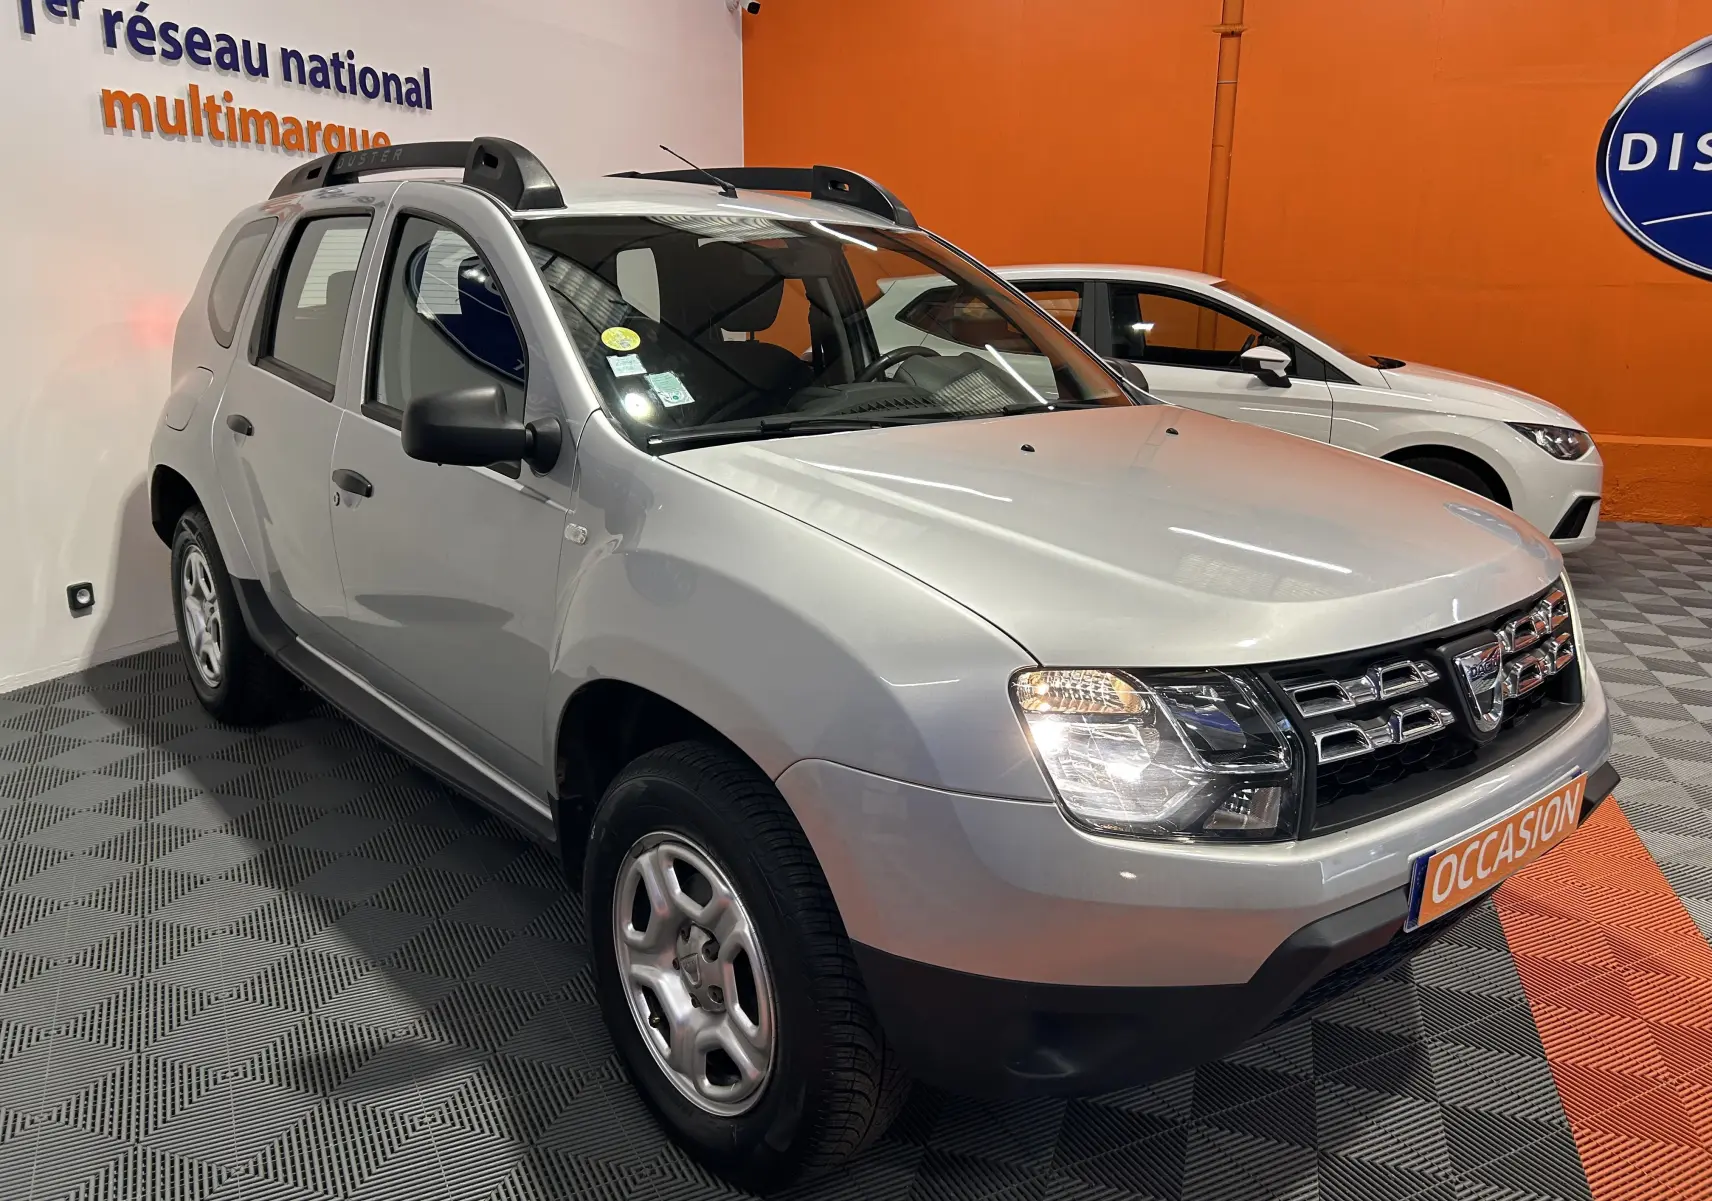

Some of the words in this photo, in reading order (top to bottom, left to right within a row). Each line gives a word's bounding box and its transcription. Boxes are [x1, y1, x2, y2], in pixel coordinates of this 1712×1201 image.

[102, 2, 269, 79] réseau
[281, 48, 433, 110] national
[337, 148, 403, 170] DUSTER
[1432, 783, 1580, 904] OCCASION
